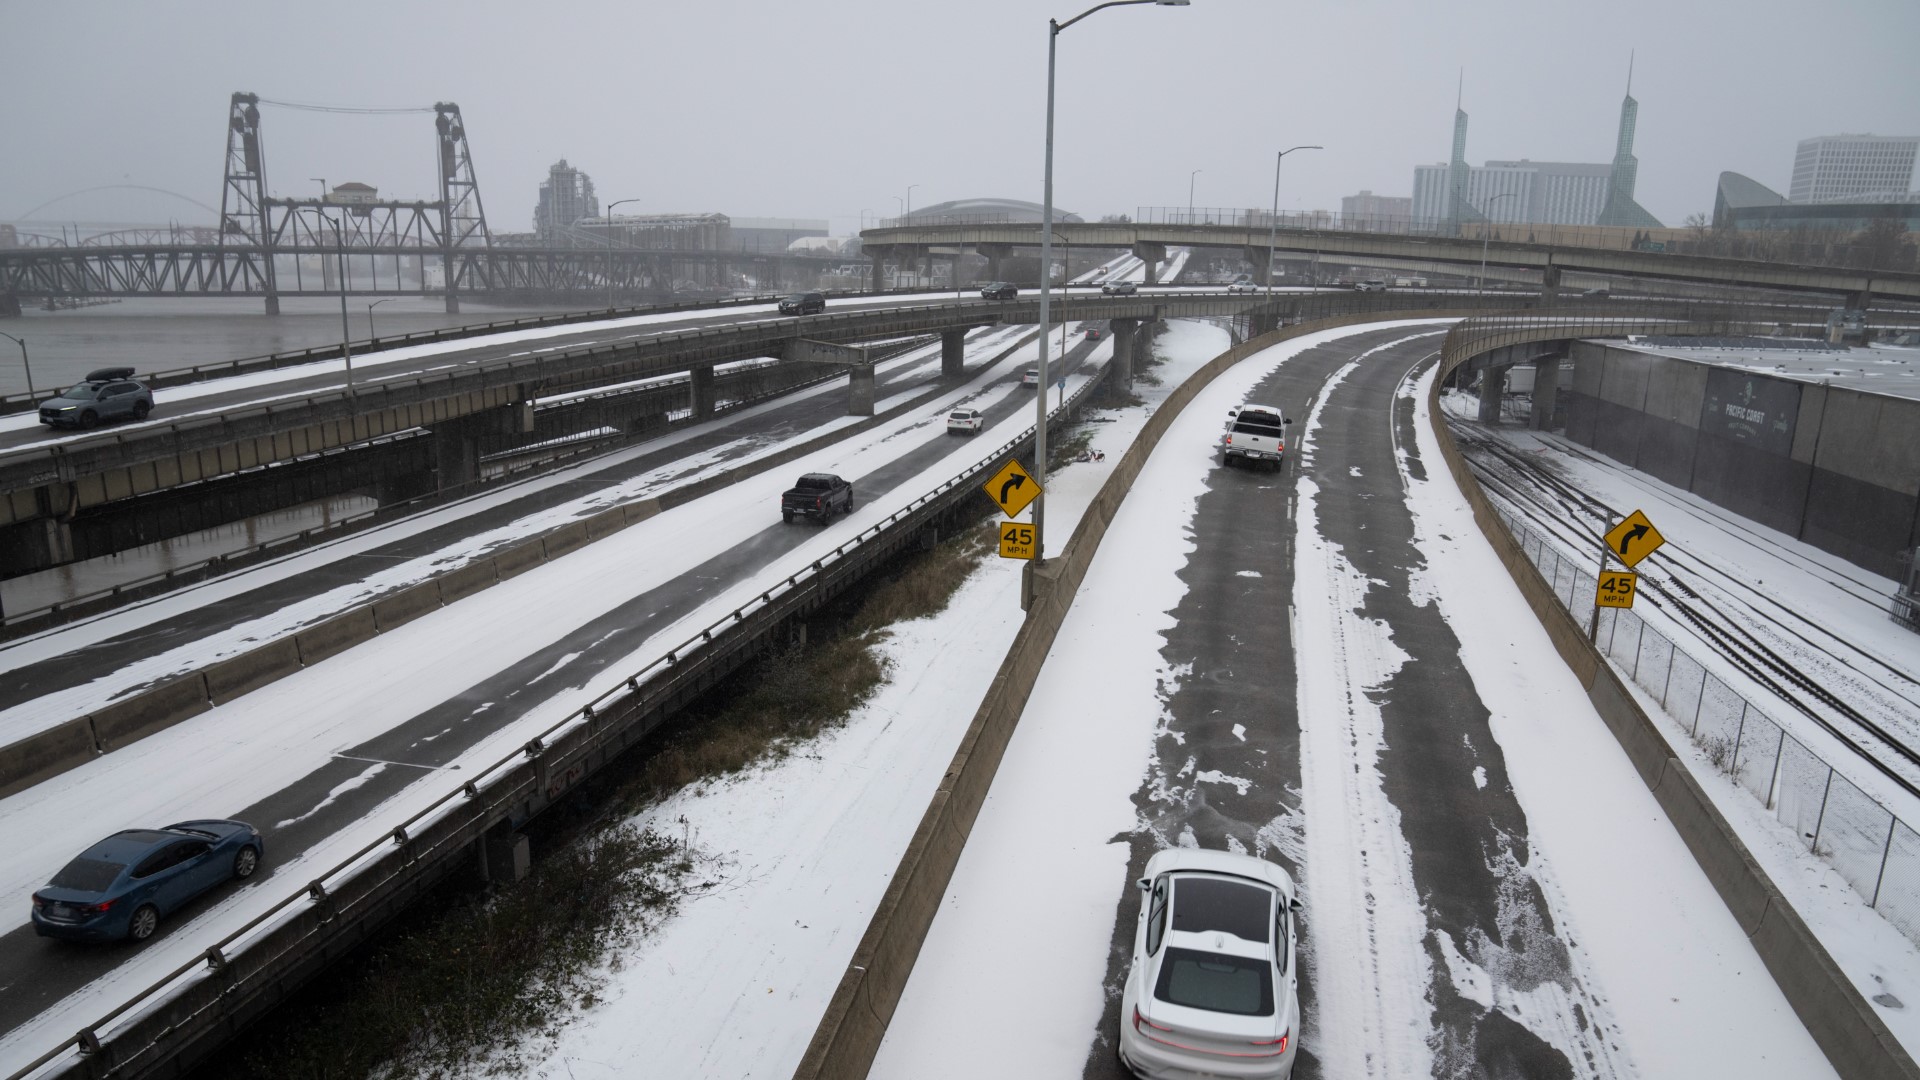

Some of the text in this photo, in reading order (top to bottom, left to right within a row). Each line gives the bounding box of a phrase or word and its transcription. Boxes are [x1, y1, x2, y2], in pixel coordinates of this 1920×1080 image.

[1003, 528, 1032, 545] 45
[1007, 546, 1028, 555] MPH
[1601, 577, 1631, 594] 45
[1603, 595, 1625, 603] MPH
